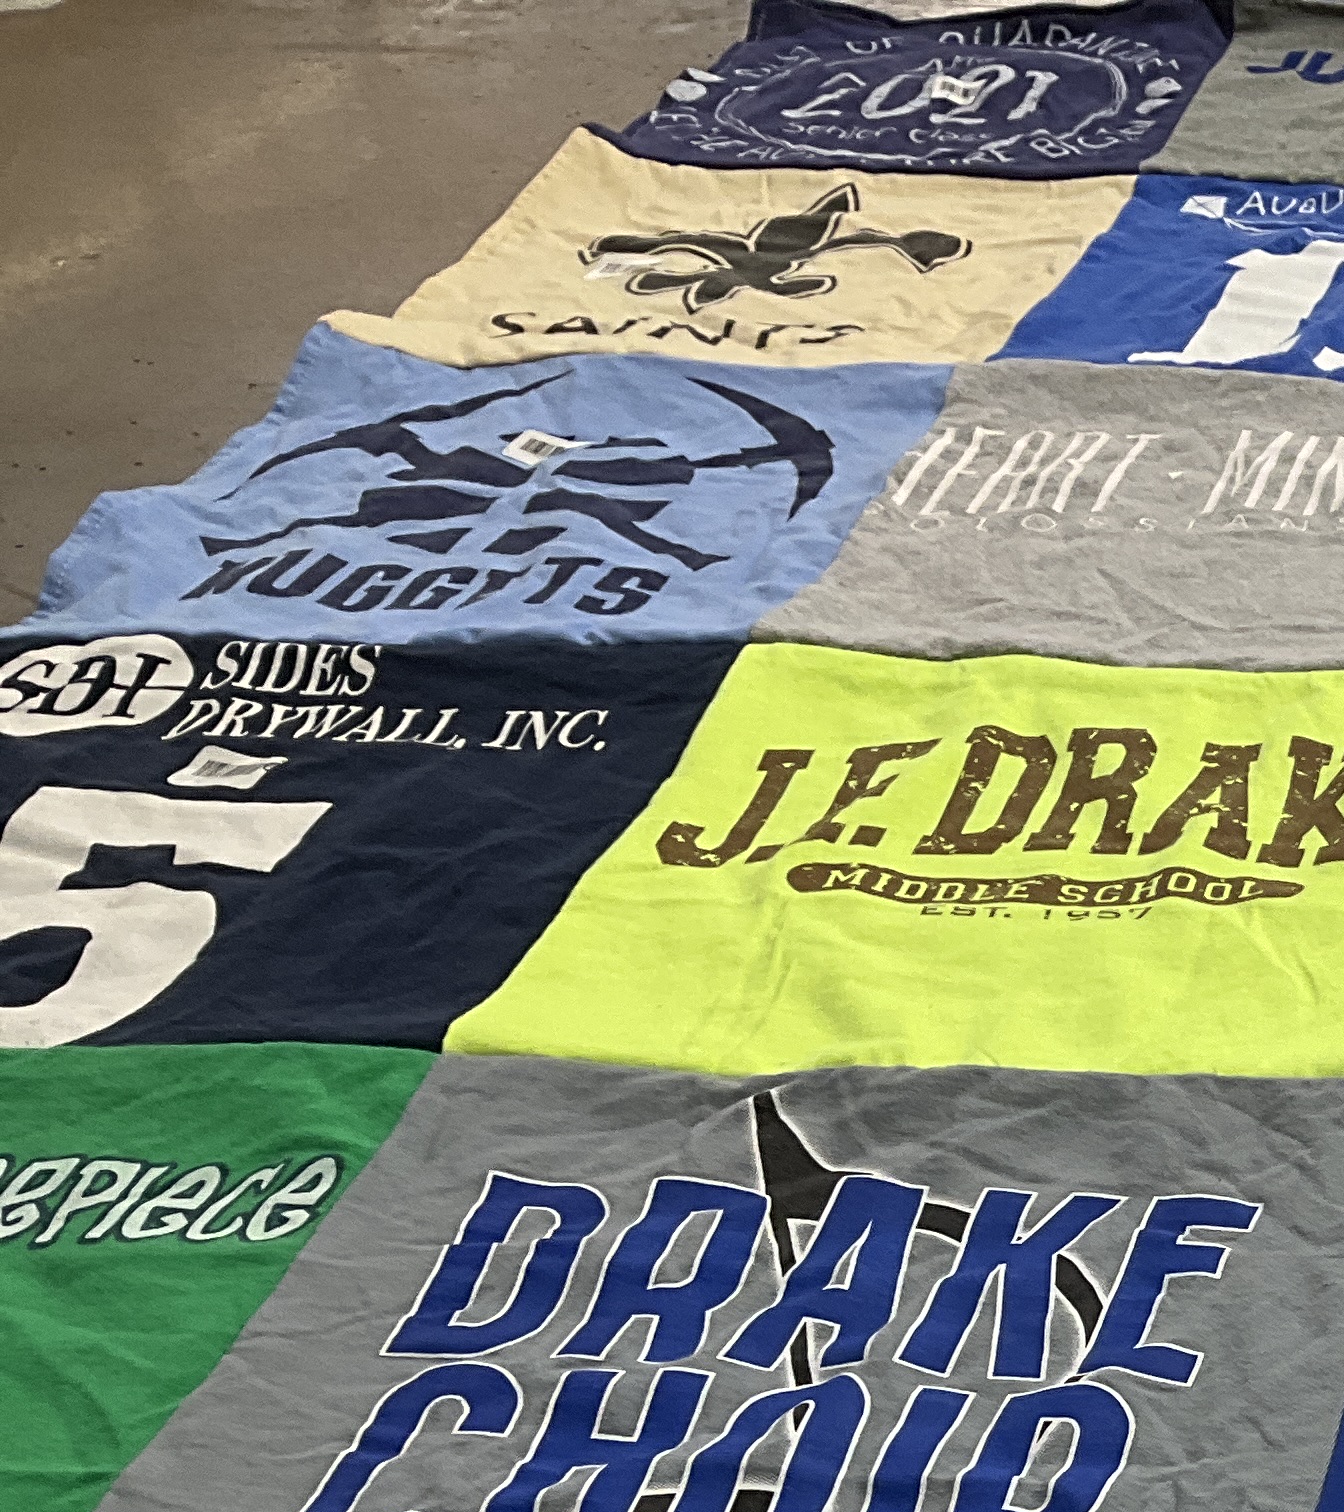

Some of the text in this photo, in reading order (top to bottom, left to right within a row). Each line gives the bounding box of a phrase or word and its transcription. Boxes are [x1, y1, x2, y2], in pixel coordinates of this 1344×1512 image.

[490, 312, 866, 350] SAINTS
[179, 547, 671, 614] NUGGETS
[200, 639, 384, 698] SIDES
[483, 709, 609, 752] INC.
[821, 866, 1266, 904] MIDDLE SCHOOL
[0, 786, 334, 1050] 5
[919, 904, 1013, 919] EST.
[379, 1170, 1265, 1387] DRAKE
